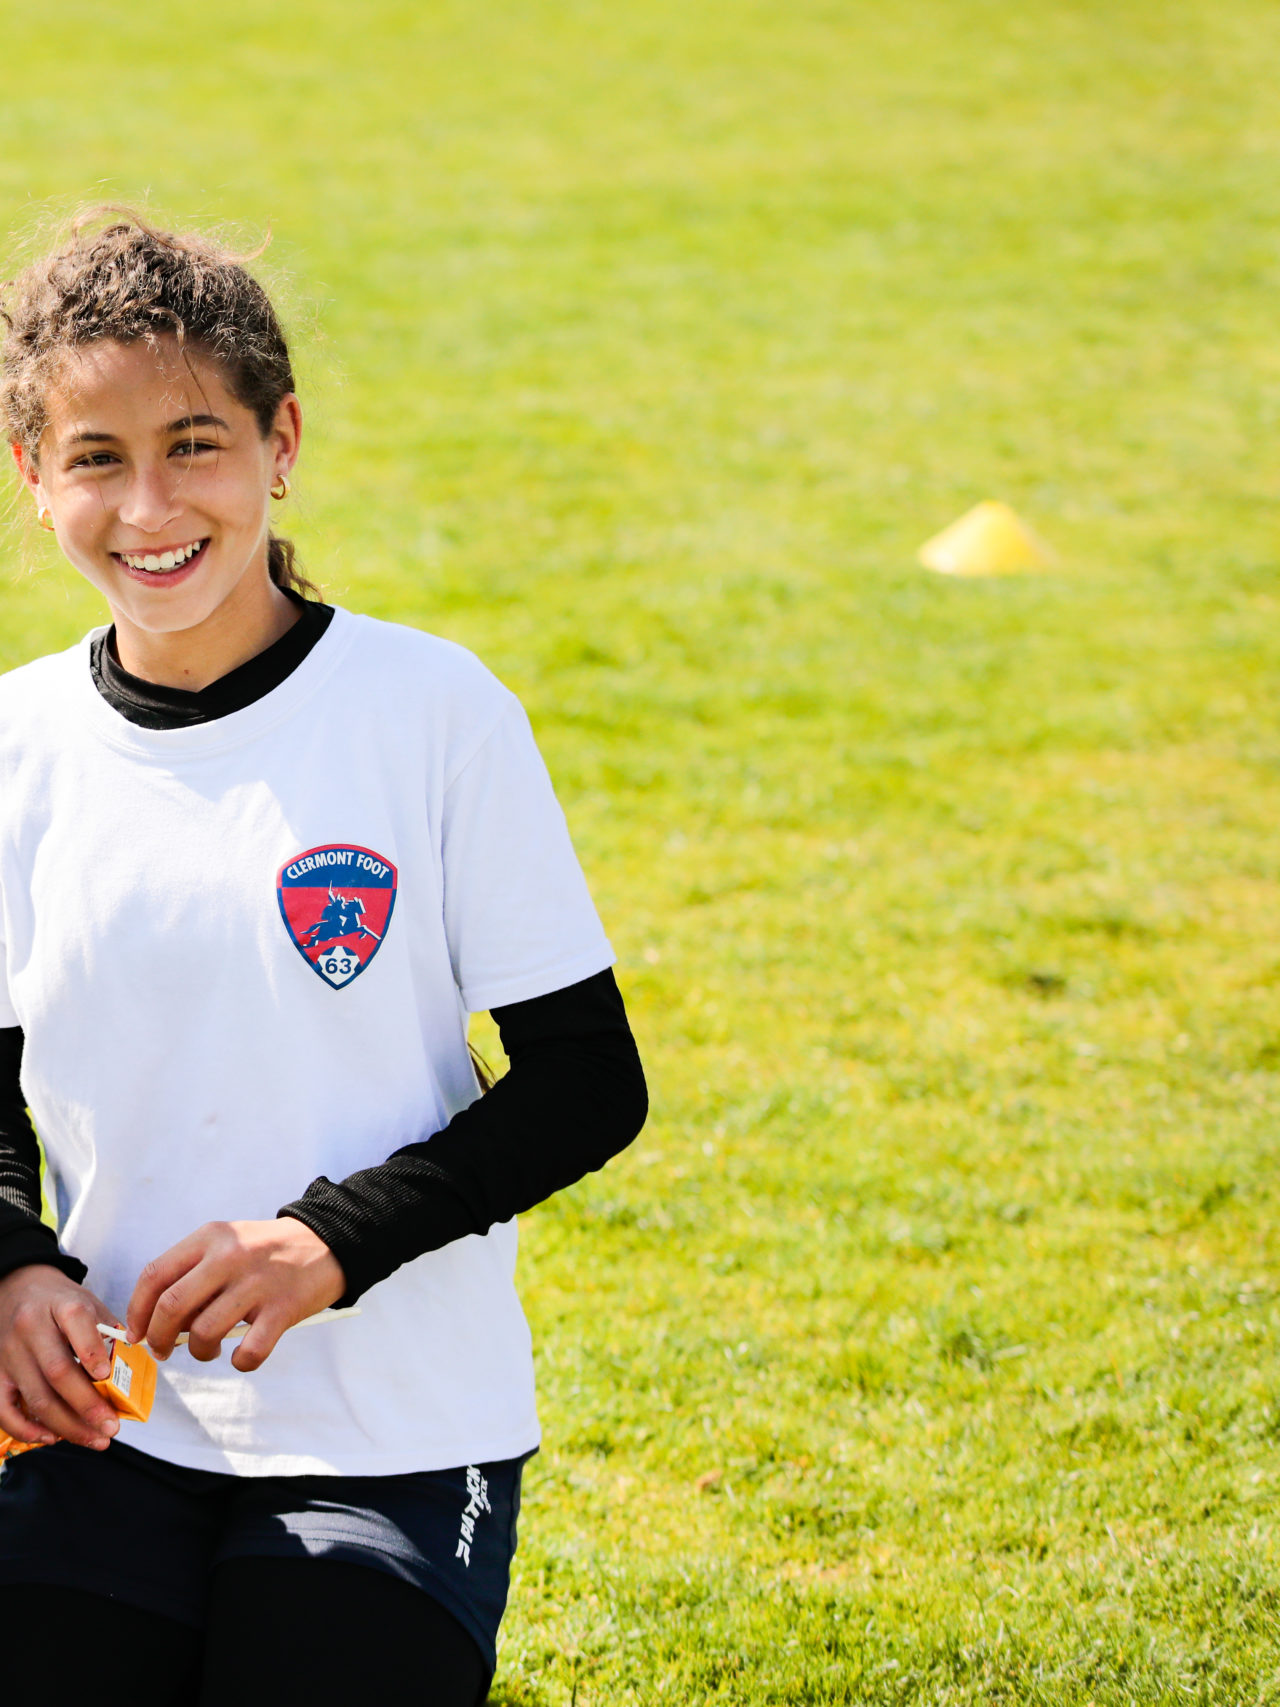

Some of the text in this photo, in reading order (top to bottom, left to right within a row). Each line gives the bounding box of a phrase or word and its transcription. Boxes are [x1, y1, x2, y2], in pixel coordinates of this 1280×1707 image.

[287, 851, 390, 880] CLERMONT FOOT
[325, 957, 352, 975] 63
